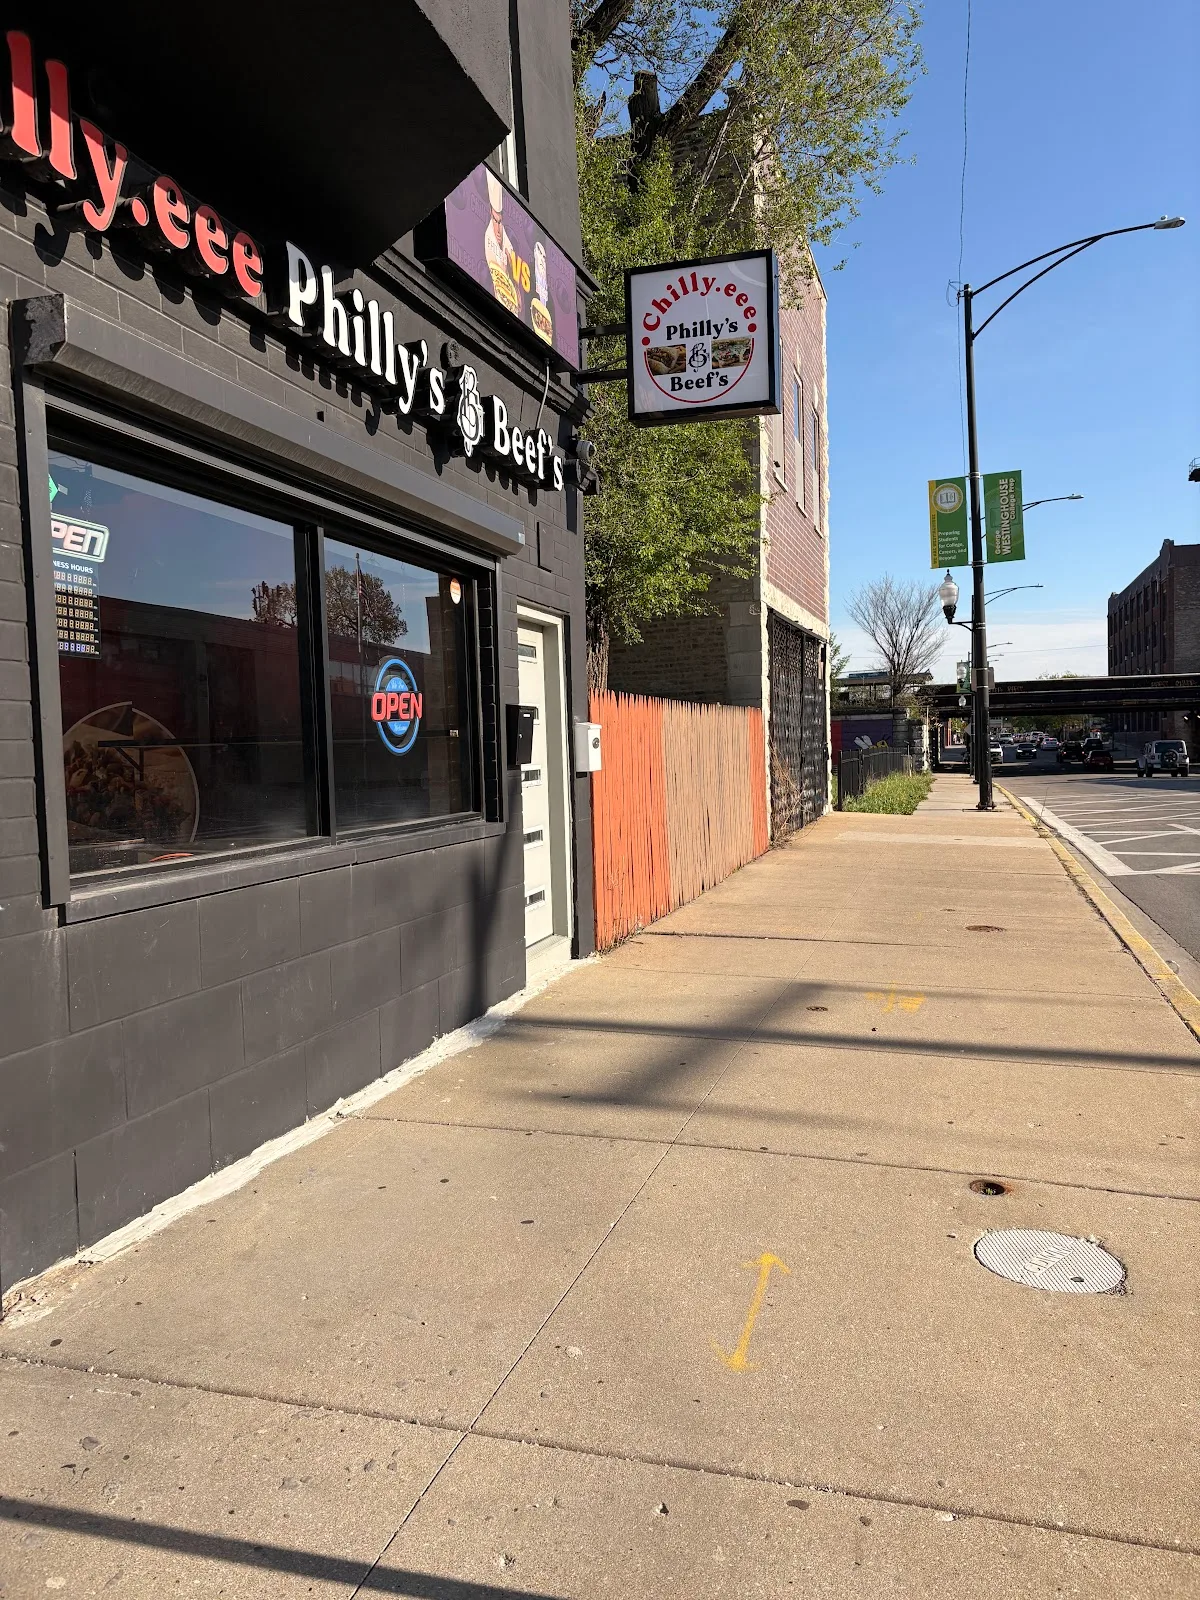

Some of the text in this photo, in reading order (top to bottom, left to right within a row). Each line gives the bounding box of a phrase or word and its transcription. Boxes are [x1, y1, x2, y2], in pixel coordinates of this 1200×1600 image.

[0, 30, 265, 298] lly.eee
[286, 240, 445, 415] Philly's
[493, 394, 563, 491] Beef's
[510, 250, 531, 294] VS
[642, 271, 757, 332] Chilly.eee
[666, 317, 739, 341] Philly's
[670, 371, 729, 392] Beef's
[999, 478, 1011, 555] WESTINGHOUSE
[1008, 477, 1017, 520] College Prep
[70, 563, 94, 574] HOURS
[372, 692, 423, 721] OPEN
